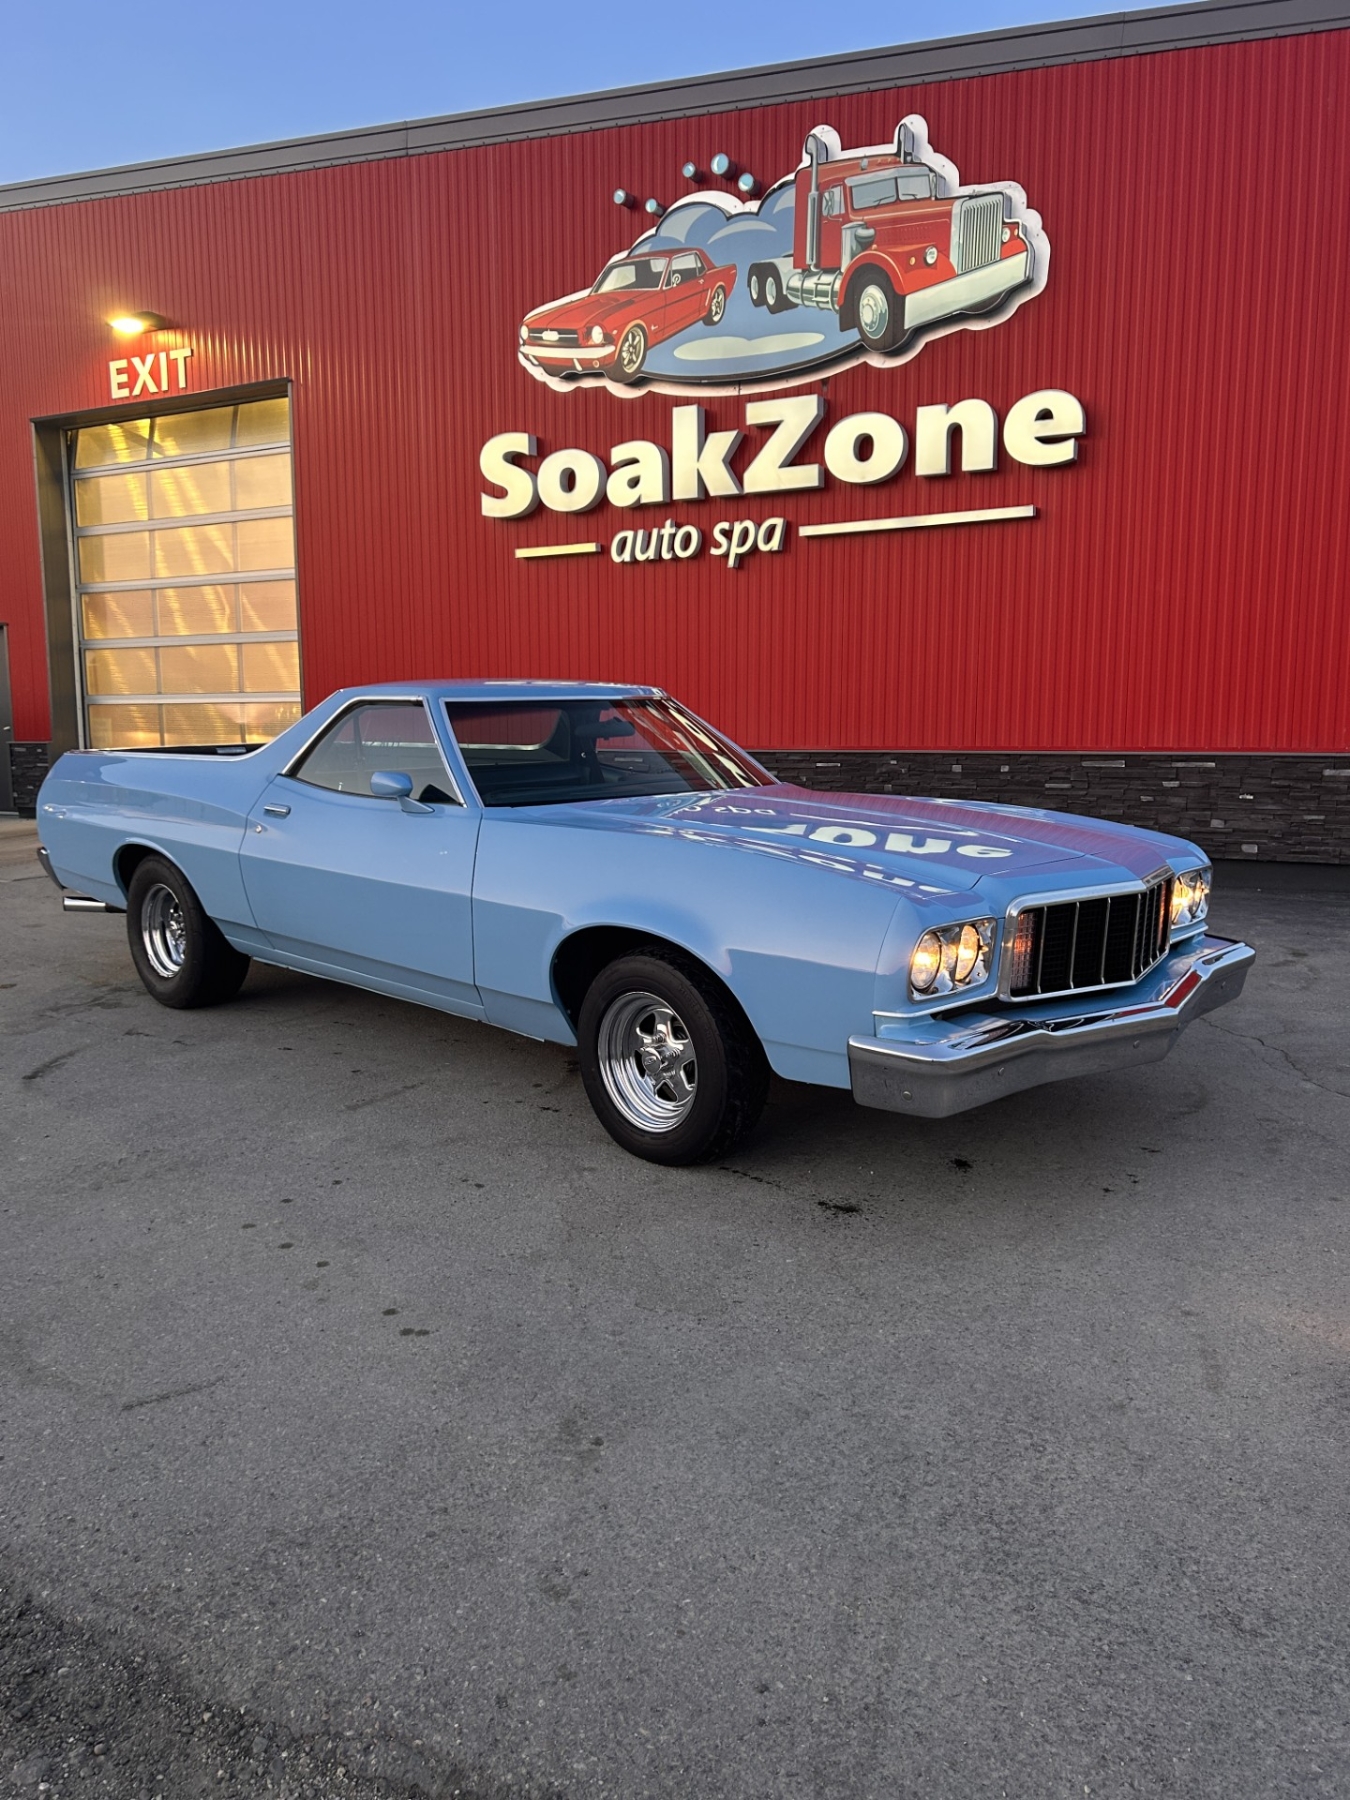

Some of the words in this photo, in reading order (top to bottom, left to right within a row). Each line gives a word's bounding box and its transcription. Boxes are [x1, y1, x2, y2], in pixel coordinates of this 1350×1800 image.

[109, 348, 193, 399] EXIT
[479, 388, 1087, 519] SoakZone
[610, 518, 702, 563] auto
[709, 517, 787, 568] spa
